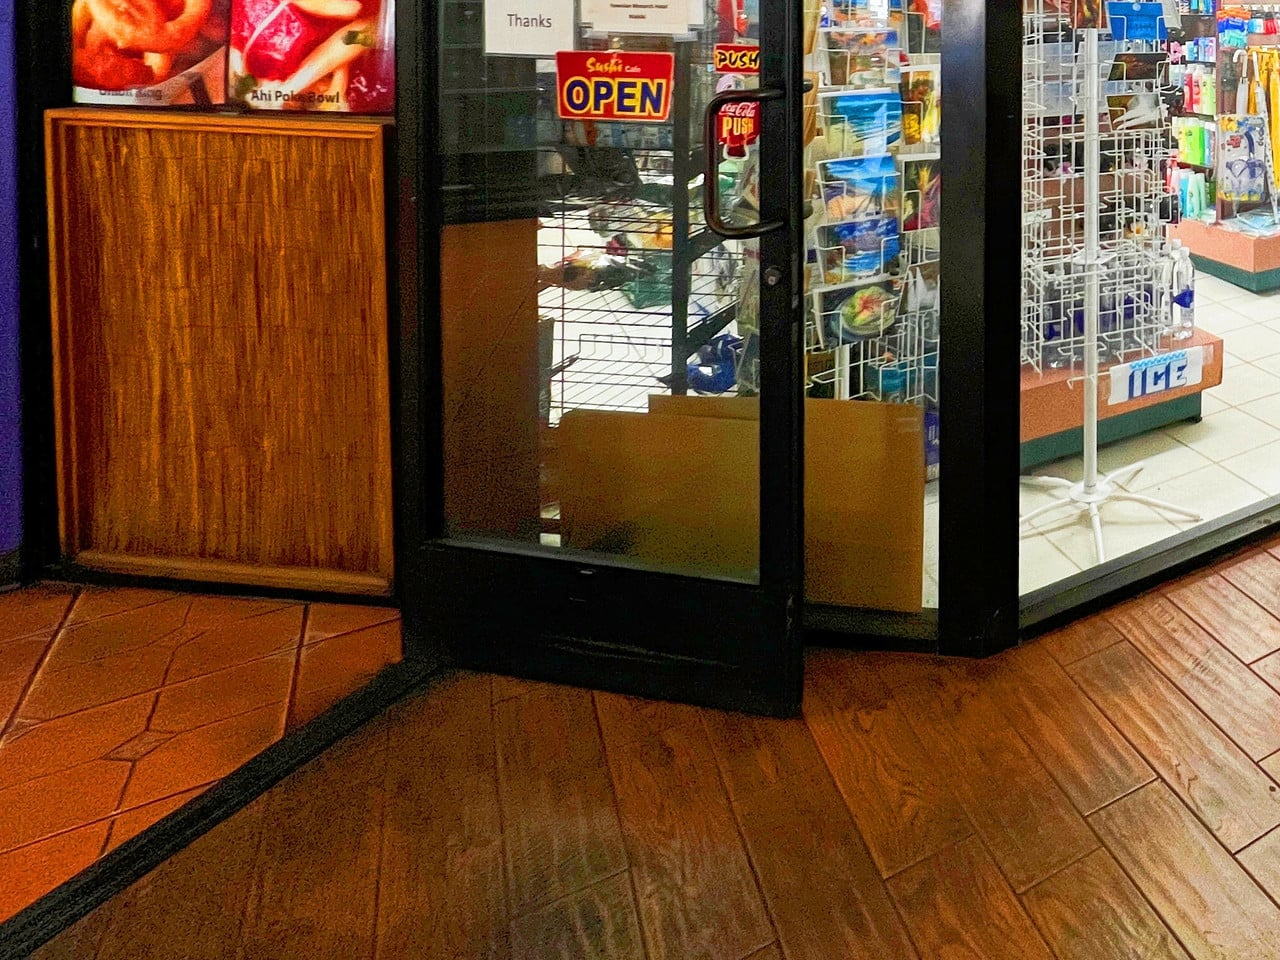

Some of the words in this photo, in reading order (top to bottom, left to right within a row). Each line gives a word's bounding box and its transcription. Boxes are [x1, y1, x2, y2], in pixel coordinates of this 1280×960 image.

[507, 13, 553, 29] Thanks
[586, 56, 624, 74] Sushi
[717, 49, 760, 69] PUSH
[251, 90, 272, 102] Ahi
[563, 76, 667, 117] OPEN
[722, 116, 754, 138] PUSH
[1128, 357, 1188, 401] ICE
